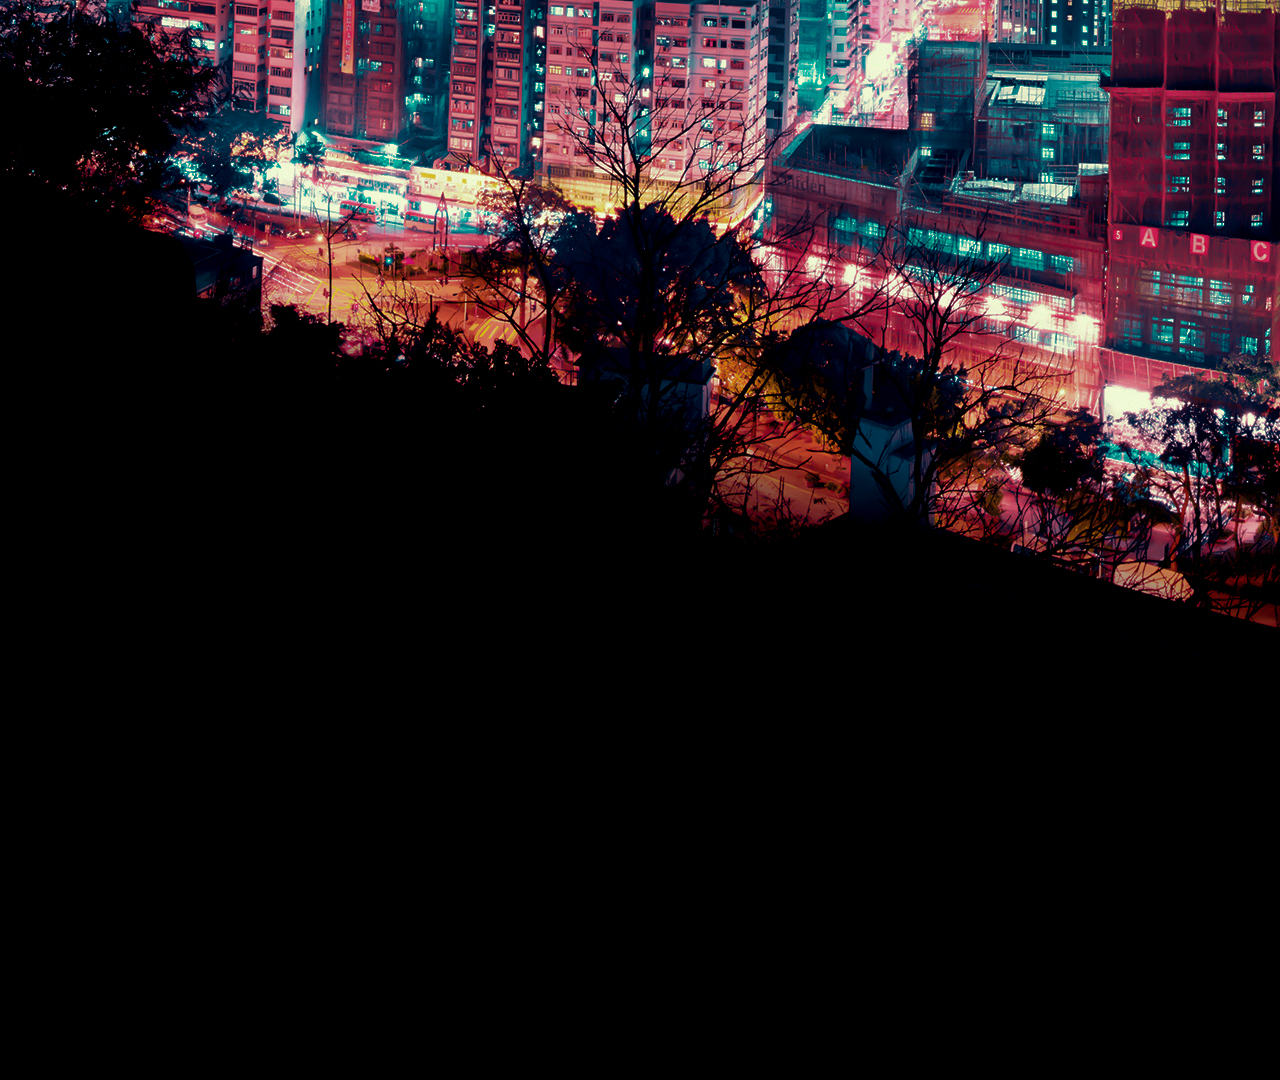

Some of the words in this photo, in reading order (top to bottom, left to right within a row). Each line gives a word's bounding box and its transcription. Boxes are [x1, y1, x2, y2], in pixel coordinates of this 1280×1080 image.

[1115, 230, 1121, 240] 5
[1140, 228, 1157, 247] A
[1192, 234, 1206, 254] B
[1253, 242, 1268, 261] C
